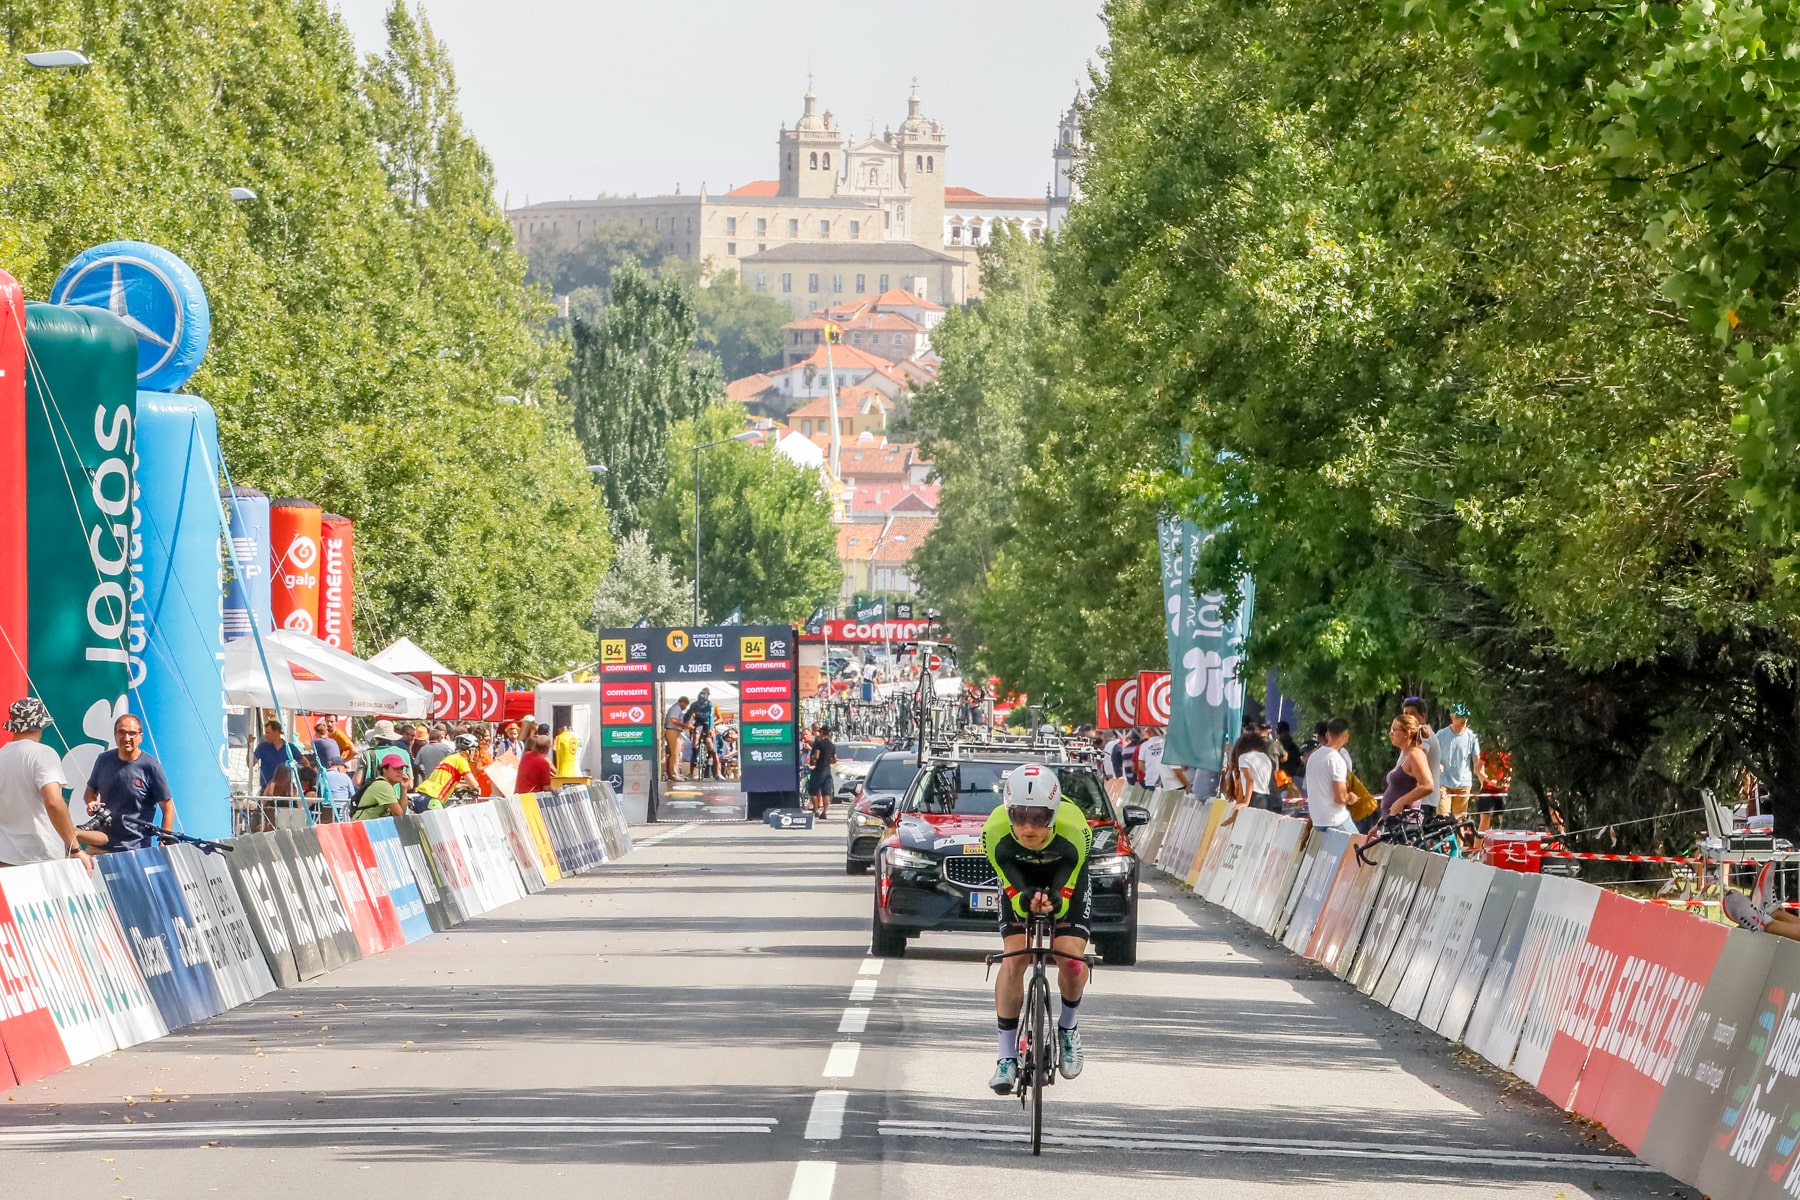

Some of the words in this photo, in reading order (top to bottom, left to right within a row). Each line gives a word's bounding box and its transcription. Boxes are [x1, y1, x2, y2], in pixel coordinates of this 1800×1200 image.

[86, 403, 132, 662] JOGOS
[285, 572, 316, 590] galp
[324, 538, 343, 650] ONTINENTE
[842, 623, 941, 639] CONTIN
[692, 638, 724, 648] VISEU
[605, 664, 648, 672] CONTINENTE
[657, 664, 666, 674] 63
[679, 664, 688, 673] A.
[688, 663, 713, 673] ZUGER
[605, 688, 648, 697] CONTINENTE
[609, 710, 628, 719] galp
[749, 708, 767, 717] galp
[611, 730, 644, 738] Europcar
[751, 727, 783, 735] Europcar
[1729, 1083, 1776, 1168] Decor
